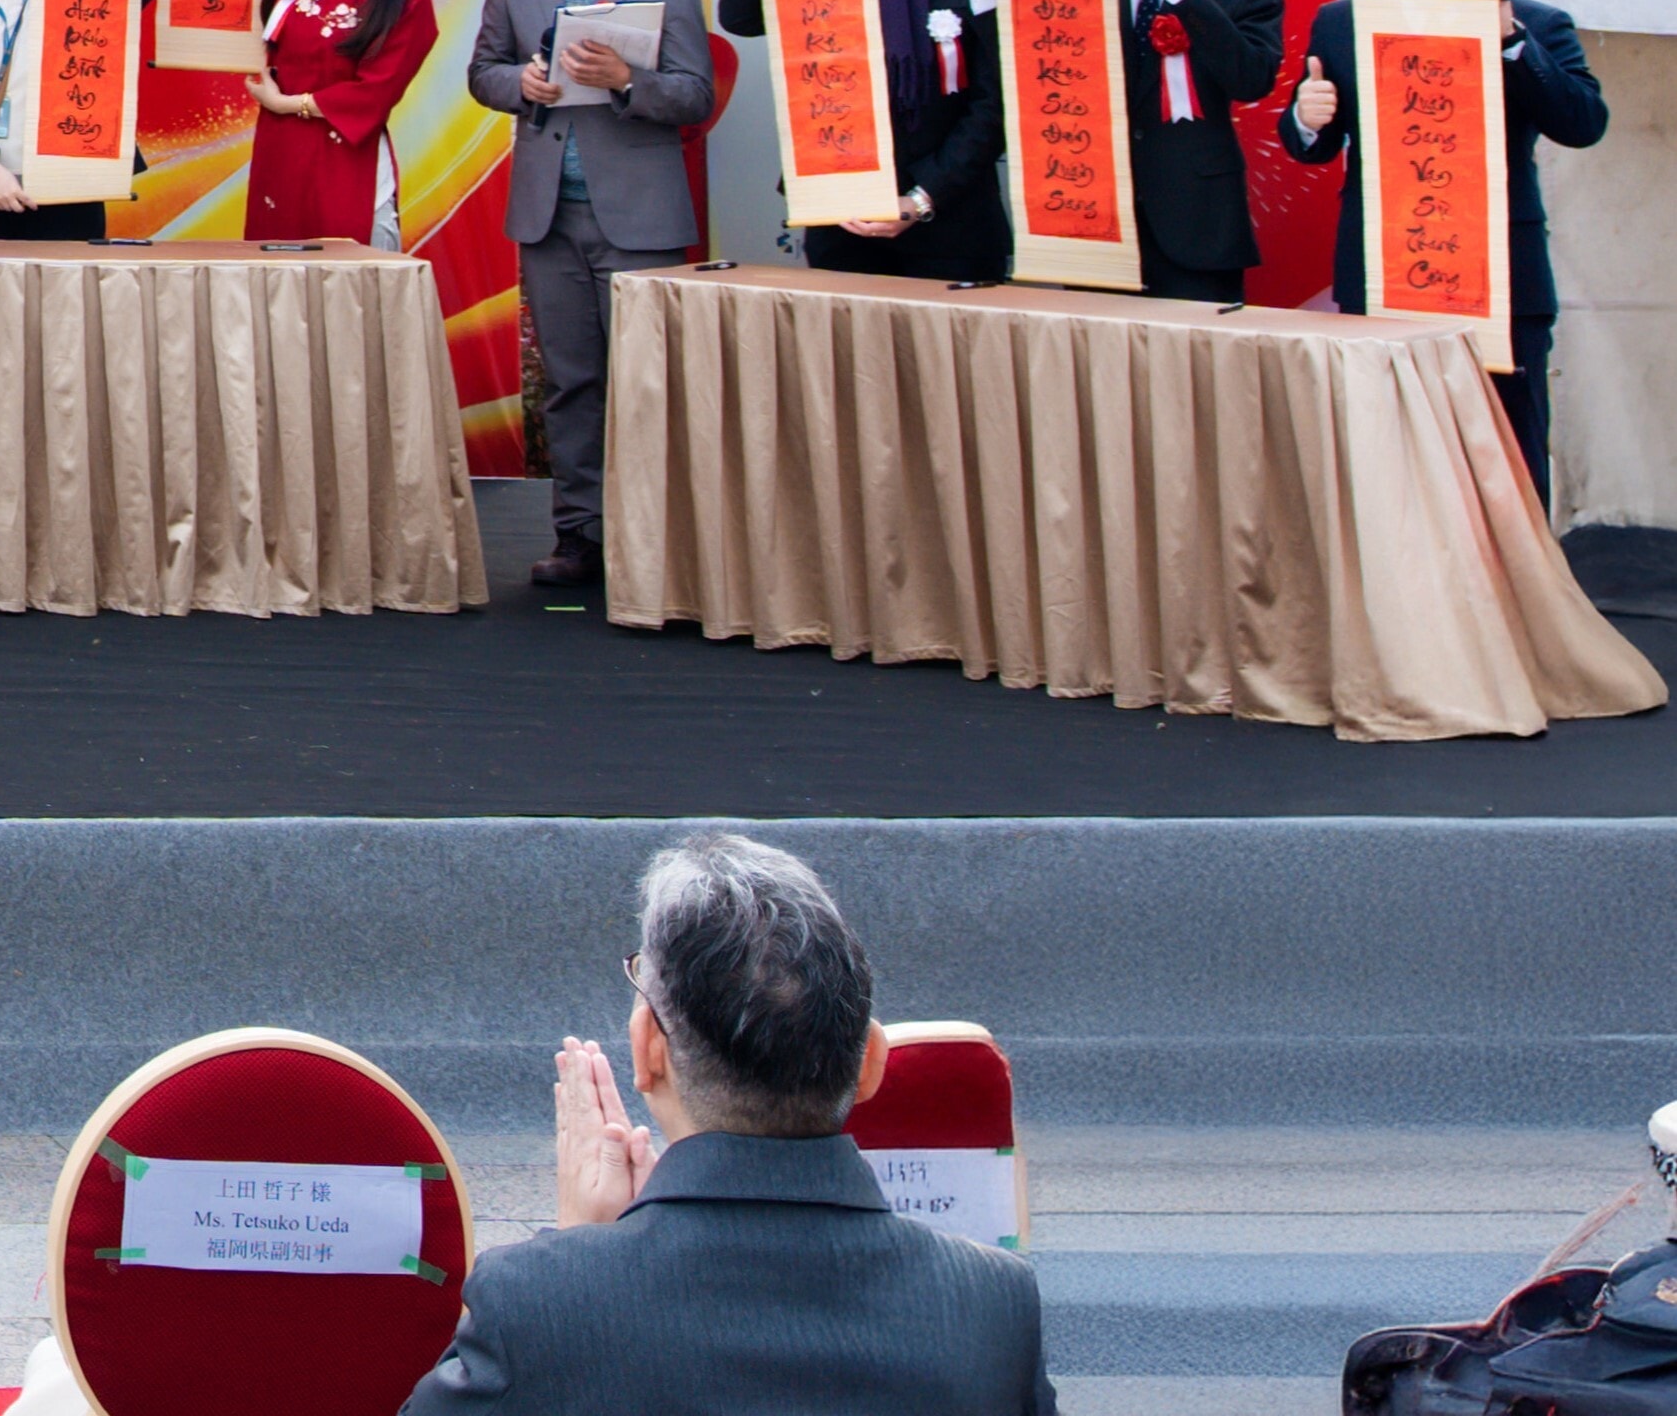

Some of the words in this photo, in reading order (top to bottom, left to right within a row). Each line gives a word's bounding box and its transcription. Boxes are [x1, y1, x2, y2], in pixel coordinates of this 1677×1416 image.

[214, 1180, 257, 1201] 上田
[263, 1180, 305, 1202] 哲子
[310, 1181, 333, 1204] 様
[193, 1211, 225, 1229] Ms.
[232, 1212, 300, 1232] Tetsuko
[305, 1215, 350, 1234] Ueda
[206, 1237, 335, 1263] 福岡県副知事
